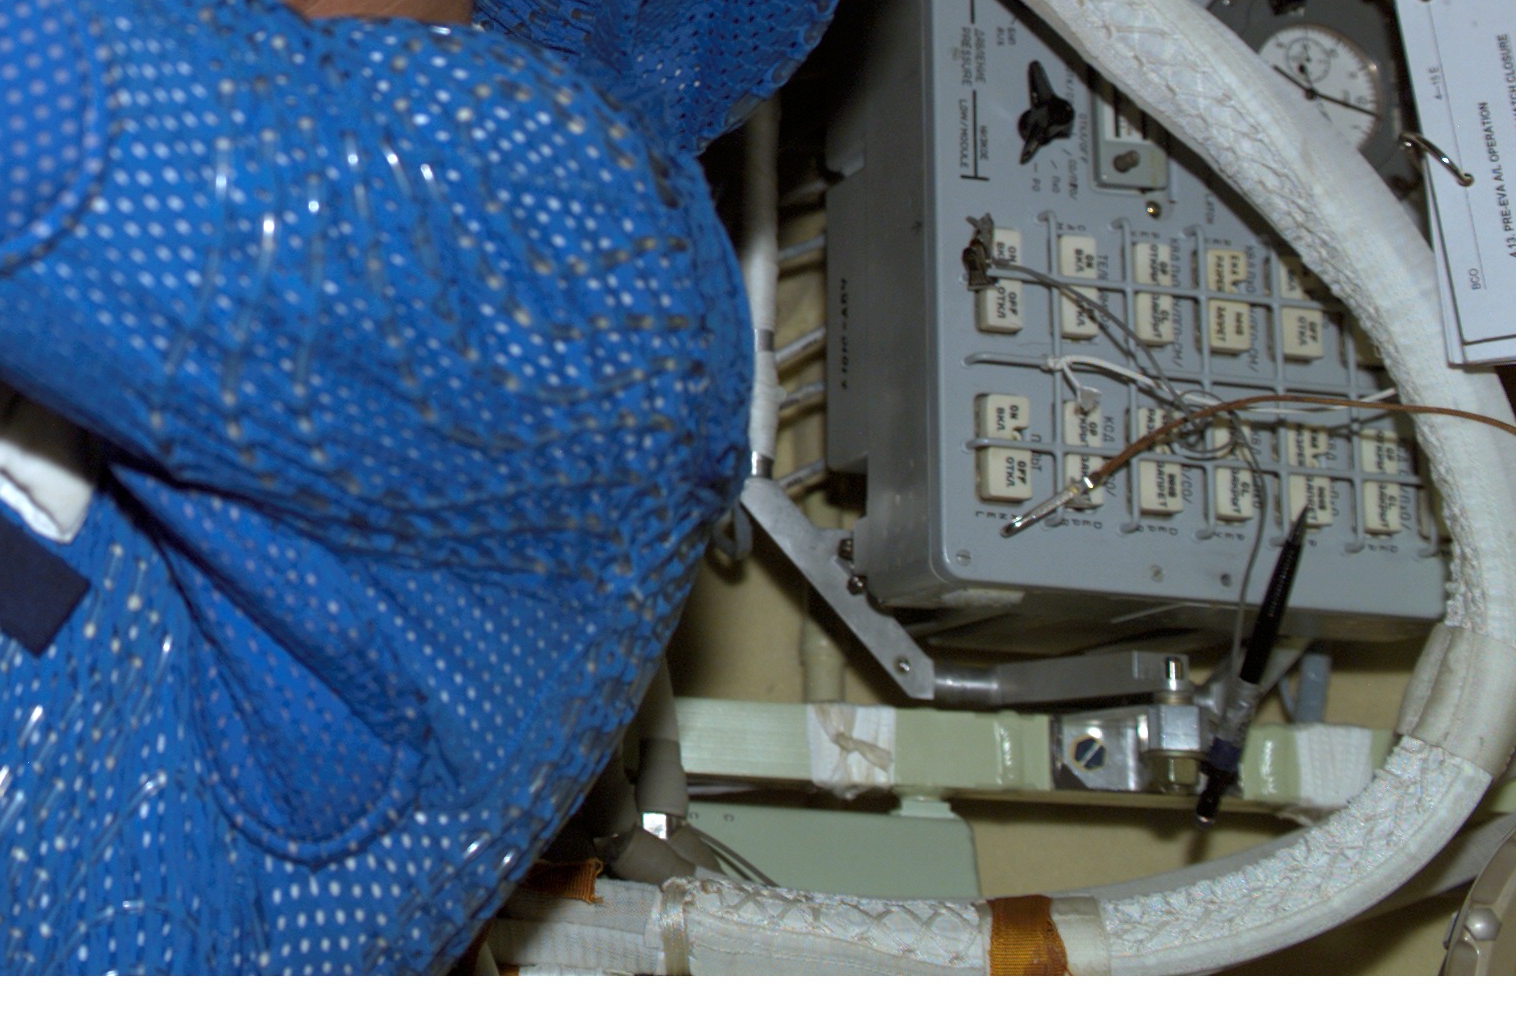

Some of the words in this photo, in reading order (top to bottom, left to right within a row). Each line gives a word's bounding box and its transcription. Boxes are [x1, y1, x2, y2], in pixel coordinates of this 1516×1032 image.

[961, 27, 972, 86] PRESSURE
[975, 28, 986, 84] ДАВЛЕНИЕ
[1497, 34, 1516, 84] CLOSURE
[959, 99, 969, 169] LOW/MODULE
[979, 125, 988, 160] НИЗКОЕ
[1478, 102, 1500, 163] OPERATION
[1496, 184, 1515, 232] PRE-EVA
[996, 241, 1006, 263] ВК
[996, 286, 1007, 319] ОТКЛ
[1008, 291, 1018, 316] OFF
[996, 407, 1006, 431] ВКЛ
[1010, 405, 1020, 420] ON
[1006, 456, 1016, 487] ОТКЛ
[1017, 461, 1027, 485] OFF
